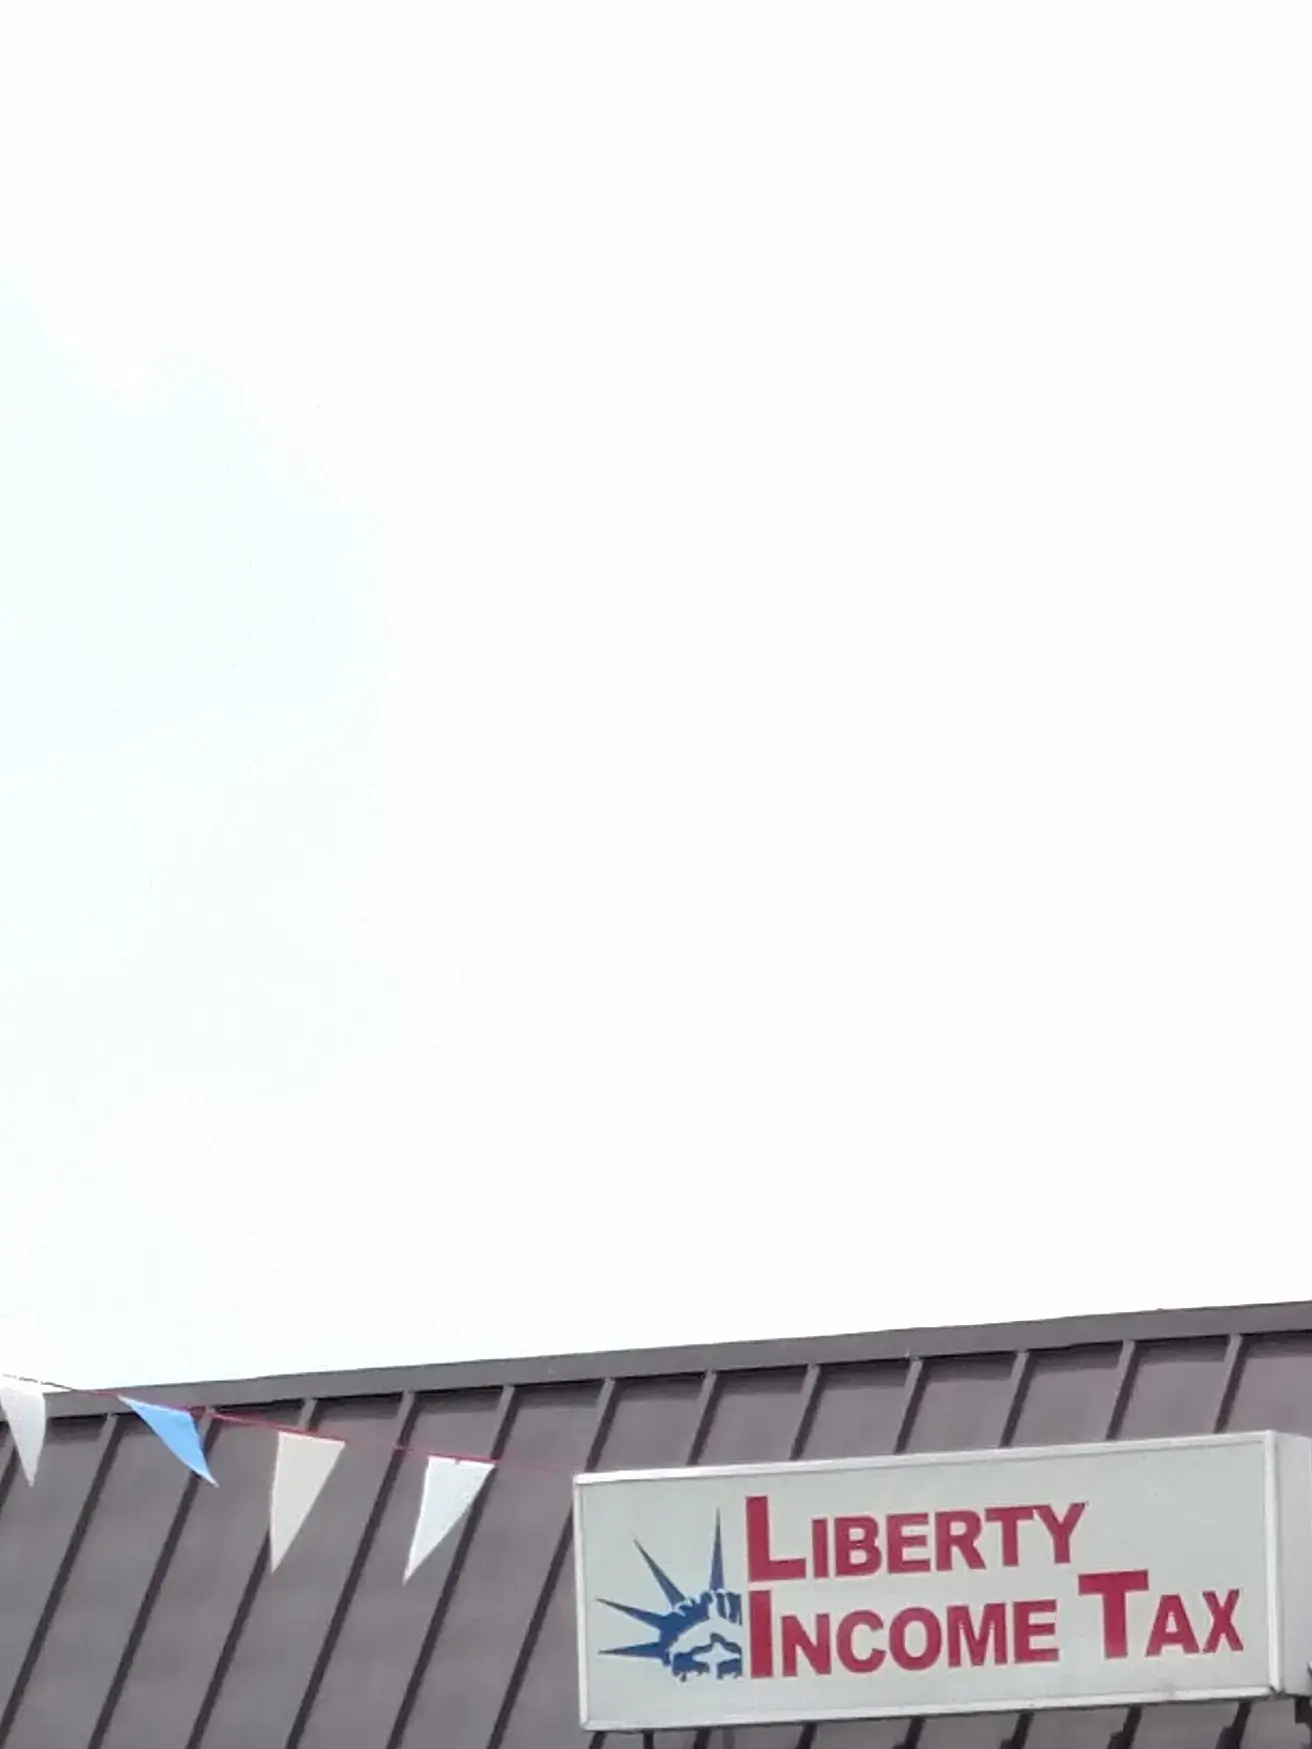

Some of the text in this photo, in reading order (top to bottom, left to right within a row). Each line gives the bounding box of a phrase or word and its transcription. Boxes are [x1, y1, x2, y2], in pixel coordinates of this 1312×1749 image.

[745, 1496, 1088, 1582] LIBERTY
[750, 1569, 1245, 1678] INCOME TAX
